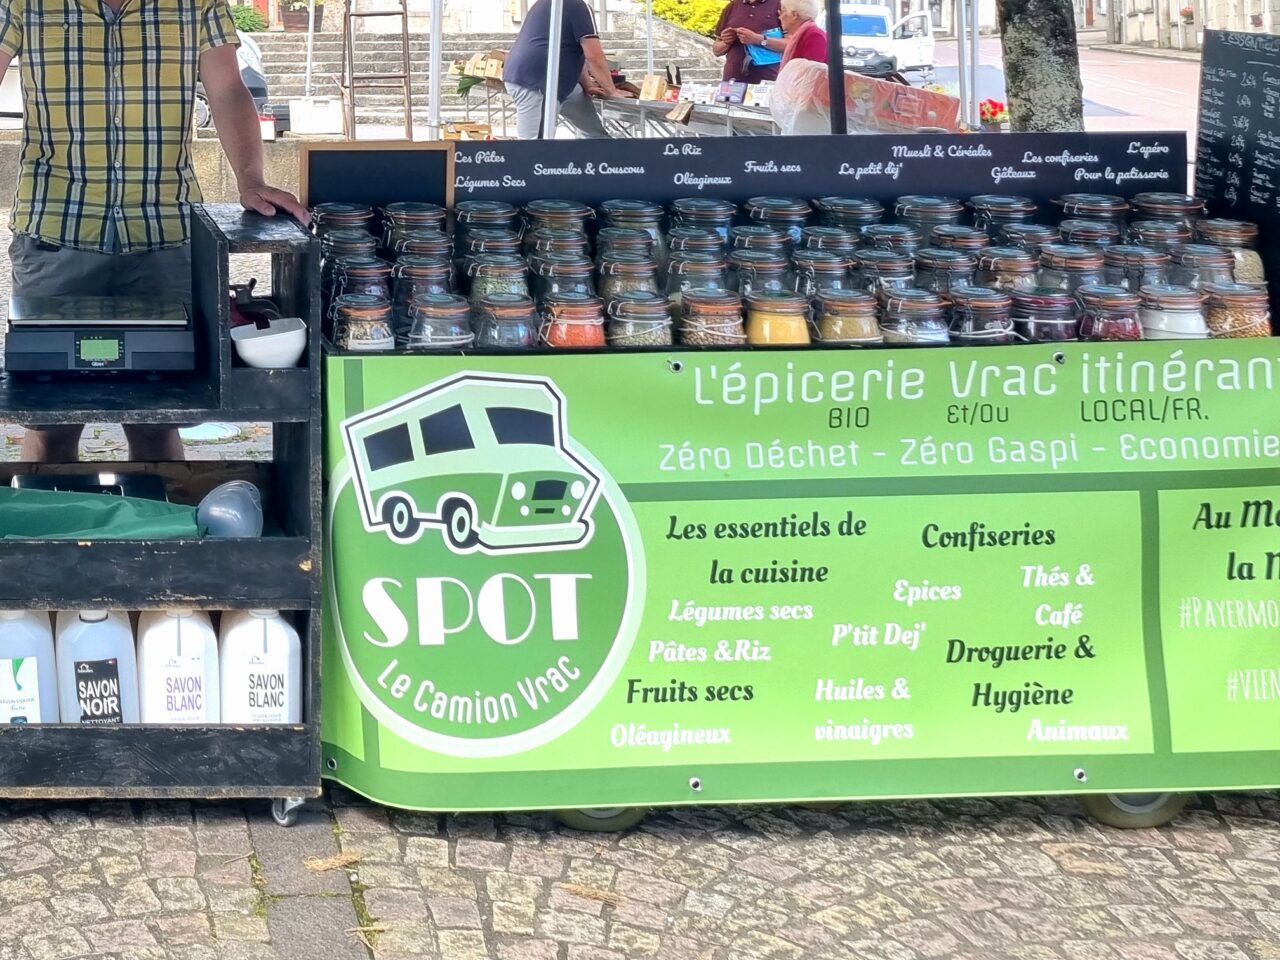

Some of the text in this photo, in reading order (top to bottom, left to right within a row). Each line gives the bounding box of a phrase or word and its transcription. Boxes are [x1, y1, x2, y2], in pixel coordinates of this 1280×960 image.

[454, 150, 505, 164] Les Pâtes
[663, 143, 702, 156] Le Riz
[891, 144, 992, 158] Muesli & Céréales
[1021, 150, 1099, 167] Les confiseries
[1126, 141, 1169, 159] L'apéro
[533, 162, 645, 176] Semoules & Couscous
[744, 160, 801, 173] Fruits secs
[838, 162, 855, 175] Le
[855, 162, 882, 180] petit
[991, 166, 1036, 184] Gâteaux
[1074, 167, 1102, 181] Pour
[1104, 167, 1115, 179] la
[454, 175, 526, 192] Légumes Secs
[673, 172, 732, 190] Oléagineux
[694, 350, 1280, 415] L'épicerie Vrac itinéran
[828, 406, 869, 429] BIO
[1081, 397, 1209, 423] LOCAL/FR.
[659, 429, 1280, 472] Zéro Déchet Zéro Gaspi Economie
[666, 511, 866, 541] Les essentiels de
[1192, 502, 1231, 530] Au
[921, 523, 1056, 553] Confiseries
[709, 560, 828, 585] la cuisine
[1021, 564, 1095, 588] Thés &
[1227, 552, 1255, 580] la
[894, 580, 962, 607] Epices
[362, 572, 592, 648] SPOT
[668, 600, 813, 626] Légumes secs
[1035, 602, 1083, 629] Café
[832, 623, 926, 650] P'tit Dej'
[648, 641, 707, 664] Pâtes
[946, 635, 1096, 668] Droguerie &
[79, 678, 118, 698] SAVON
[166, 676, 202, 693] SAVON
[248, 673, 284, 690] SAVON
[377, 656, 580, 724] Le Camion Vrac
[626, 679, 754, 704] Fruits secs
[815, 678, 911, 701] Huiles &
[80, 697, 120, 716] NOIR
[166, 694, 202, 711] BLANC
[248, 691, 284, 708] BLANC
[972, 681, 1073, 713] Hygiène
[610, 723, 731, 751] Oléagineux
[815, 721, 914, 746] vinaigres
[1026, 718, 1129, 743] Animaux
